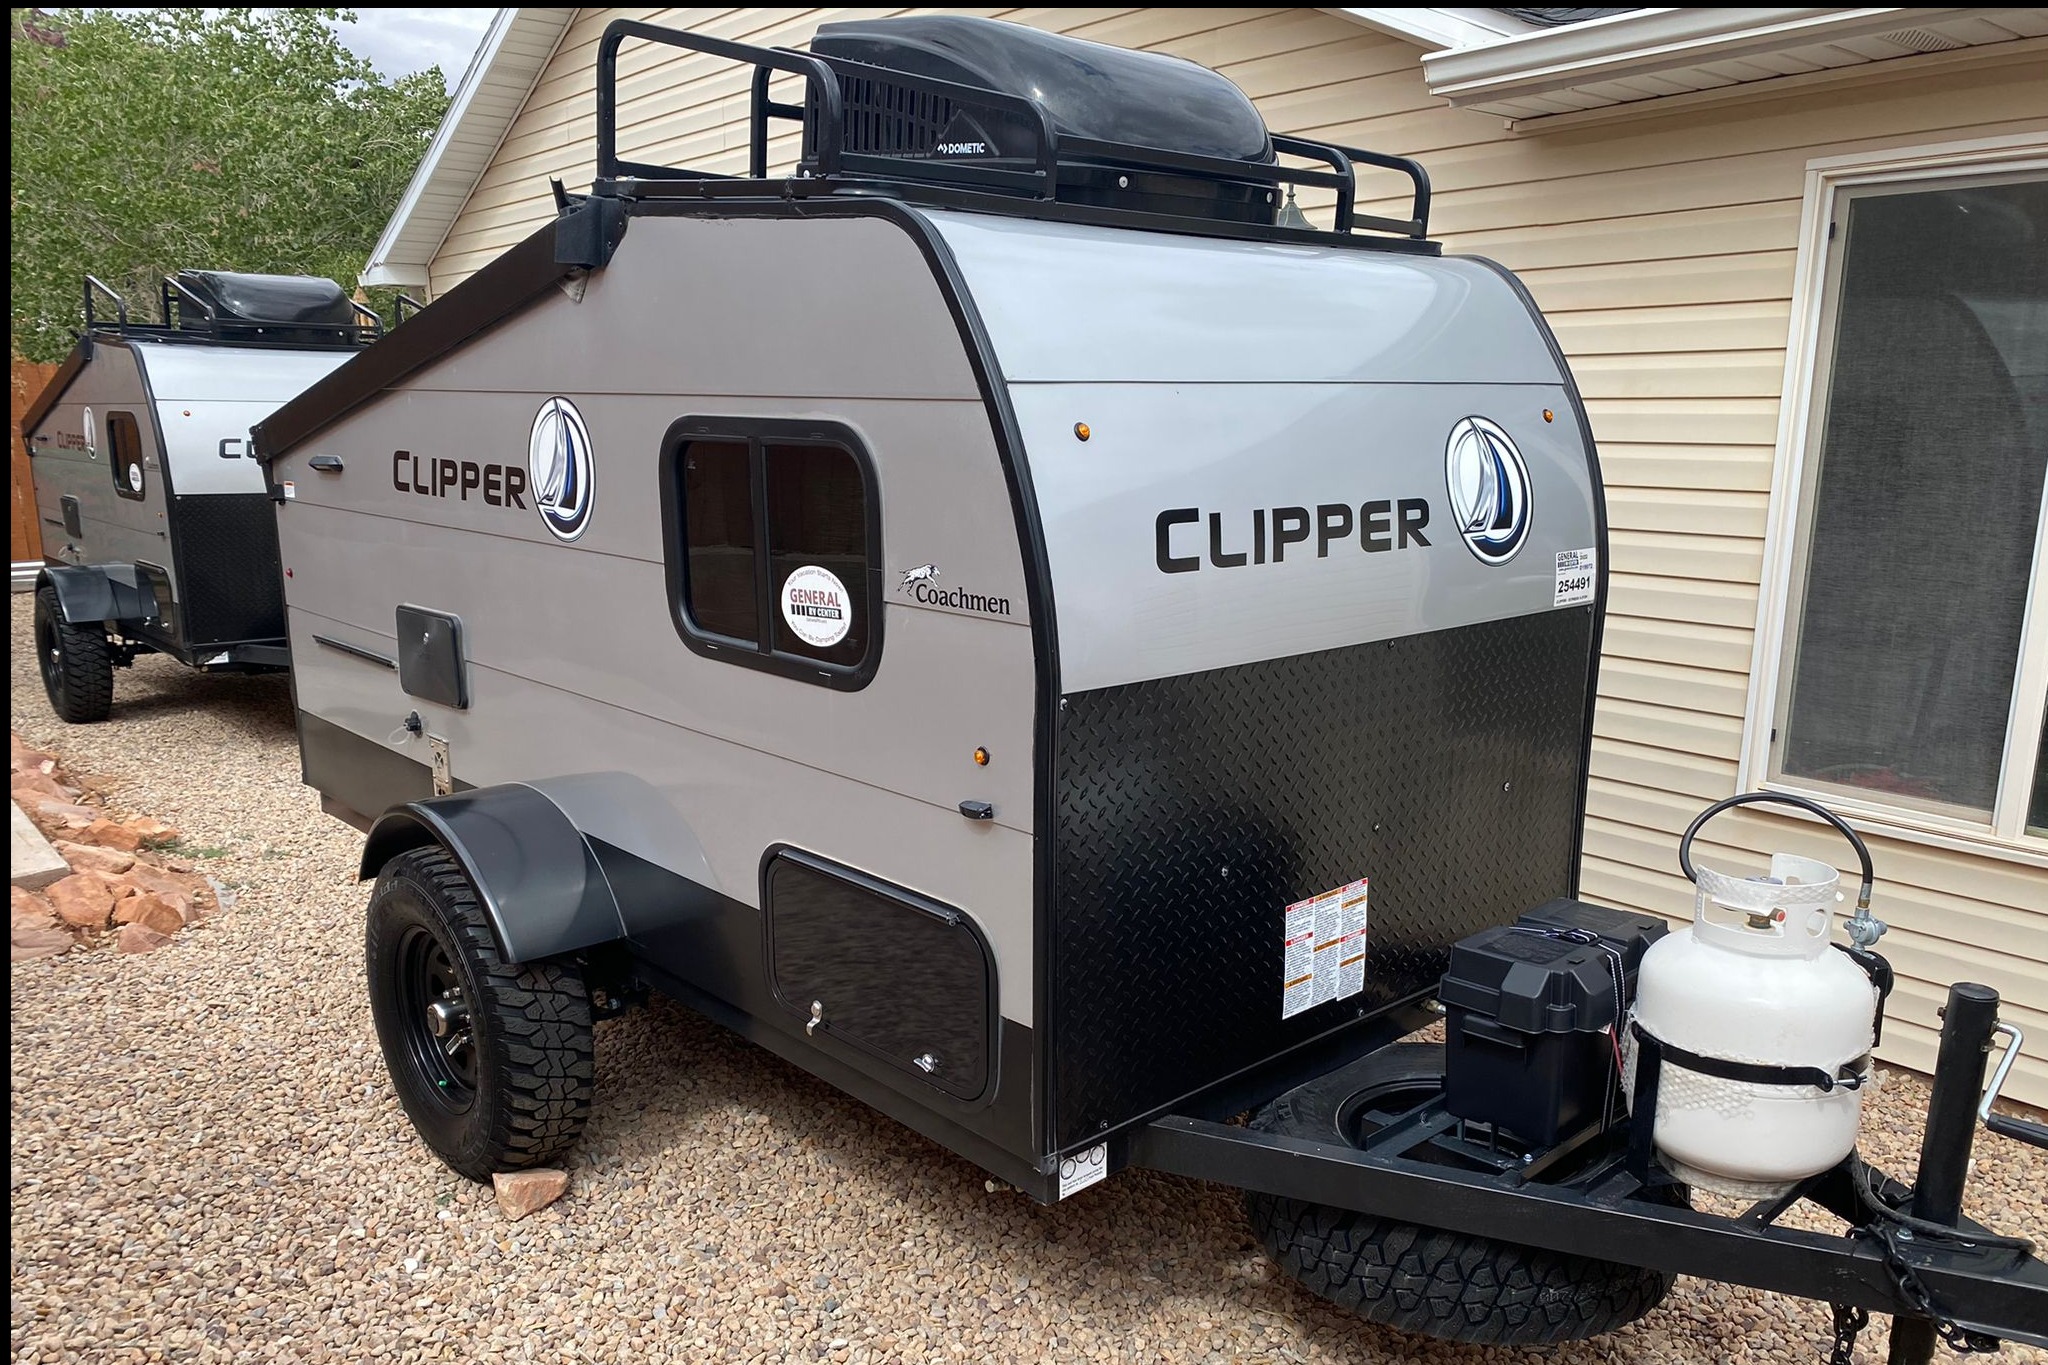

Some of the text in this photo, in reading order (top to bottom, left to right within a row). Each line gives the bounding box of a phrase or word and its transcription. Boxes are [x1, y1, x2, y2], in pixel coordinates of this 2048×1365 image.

[948, 142, 986, 154] DOMETIC
[393, 450, 527, 510] CLIPPER
[1155, 497, 1432, 574] CLIPPER
[1557, 551, 1579, 561] GENERAL
[1557, 576, 1591, 594] 254491
[789, 588, 842, 607] GENERAL
[915, 583, 1011, 615] Coachmen
[816, 607, 840, 619] CENTER
